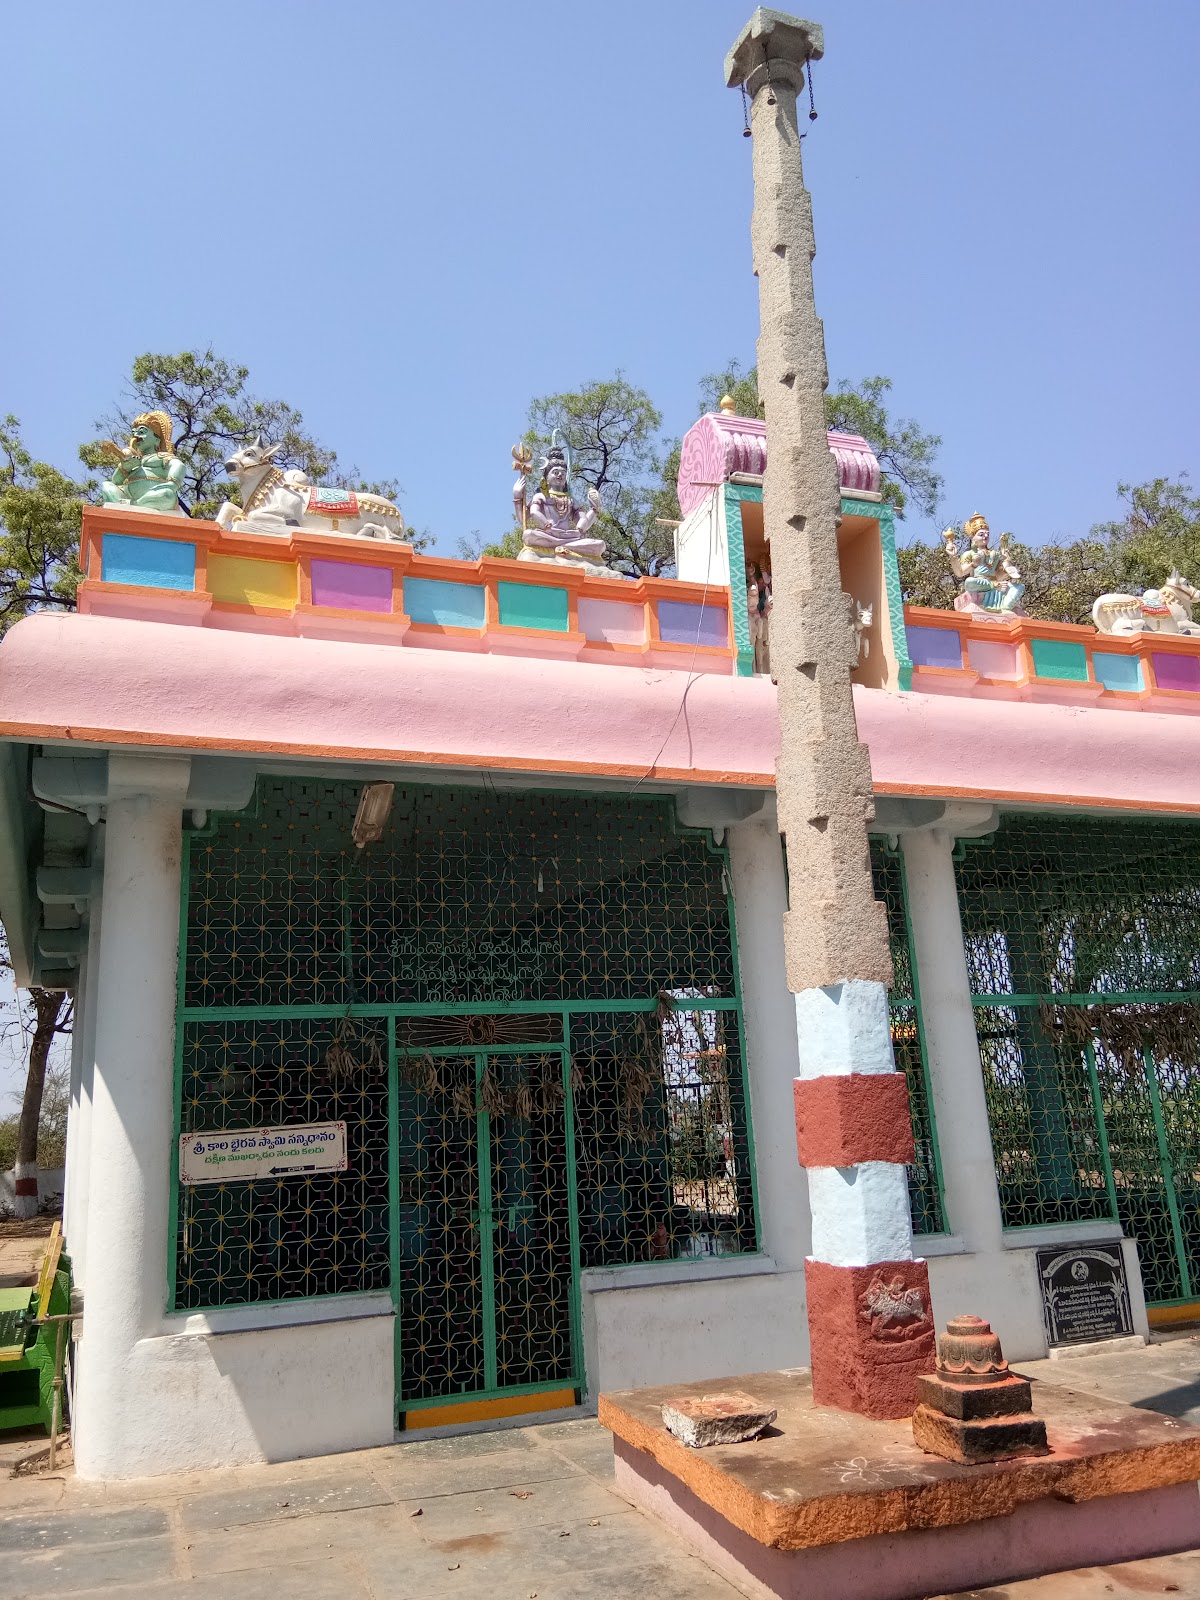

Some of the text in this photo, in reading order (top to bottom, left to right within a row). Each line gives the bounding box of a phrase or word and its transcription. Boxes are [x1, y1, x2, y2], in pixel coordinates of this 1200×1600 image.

[193, 1131, 336, 1155] శ్రీ కాల భైరవ స్వామి సన్నిధానం
[204, 1153, 226, 1165] దక్షిణ
[276, 1148, 300, 1158] నందు
[301, 1145, 325, 1155] కలదు
